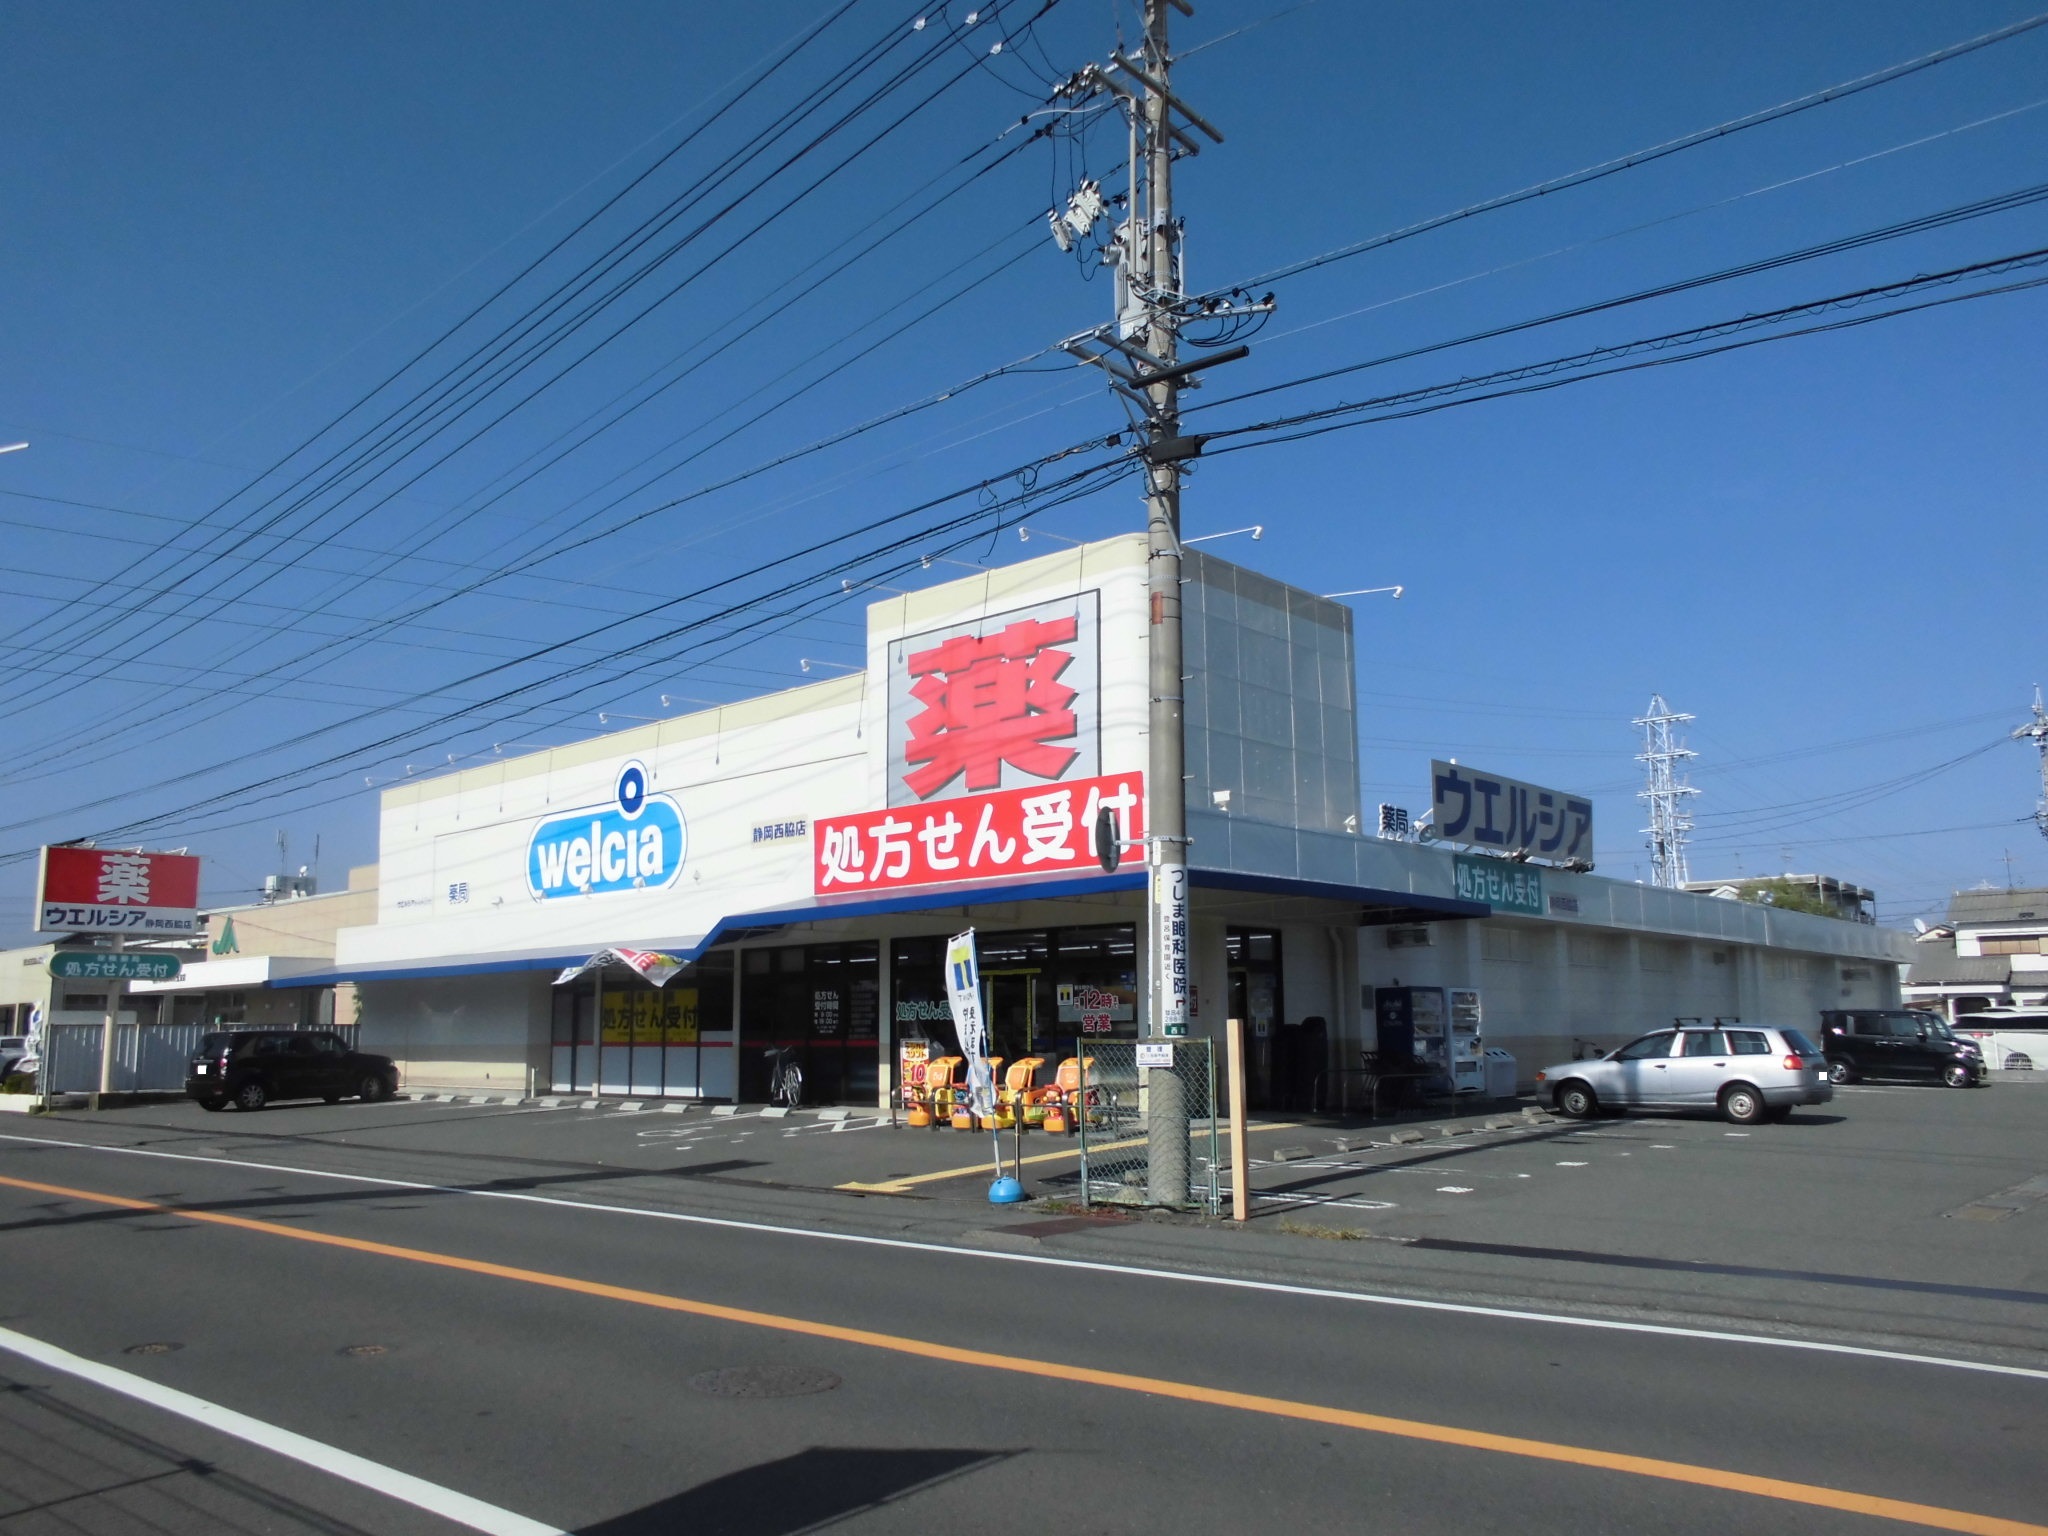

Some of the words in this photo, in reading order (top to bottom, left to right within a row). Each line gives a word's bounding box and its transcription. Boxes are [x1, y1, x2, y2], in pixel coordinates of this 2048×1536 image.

[902, 616, 1080, 800] 薬
[537, 767, 664, 888] welcia
[753, 820, 806, 843] 静岡西脇店
[1380, 804, 1408, 834] 薬局
[1435, 768, 1592, 854] ウエルシア
[821, 783, 1137, 887] 処方せん受付
[97, 854, 151, 904] 薬
[1456, 864, 1539, 907] 処方せん受付
[46, 907, 147, 926] ウエルシア
[1171, 869, 1187, 995] つしま眼科医院
[65, 962, 168, 977] 処方せん受付
[896, 1001, 953, 1021] 処方せん受
[1083, 1013, 1111, 1032] 営業
